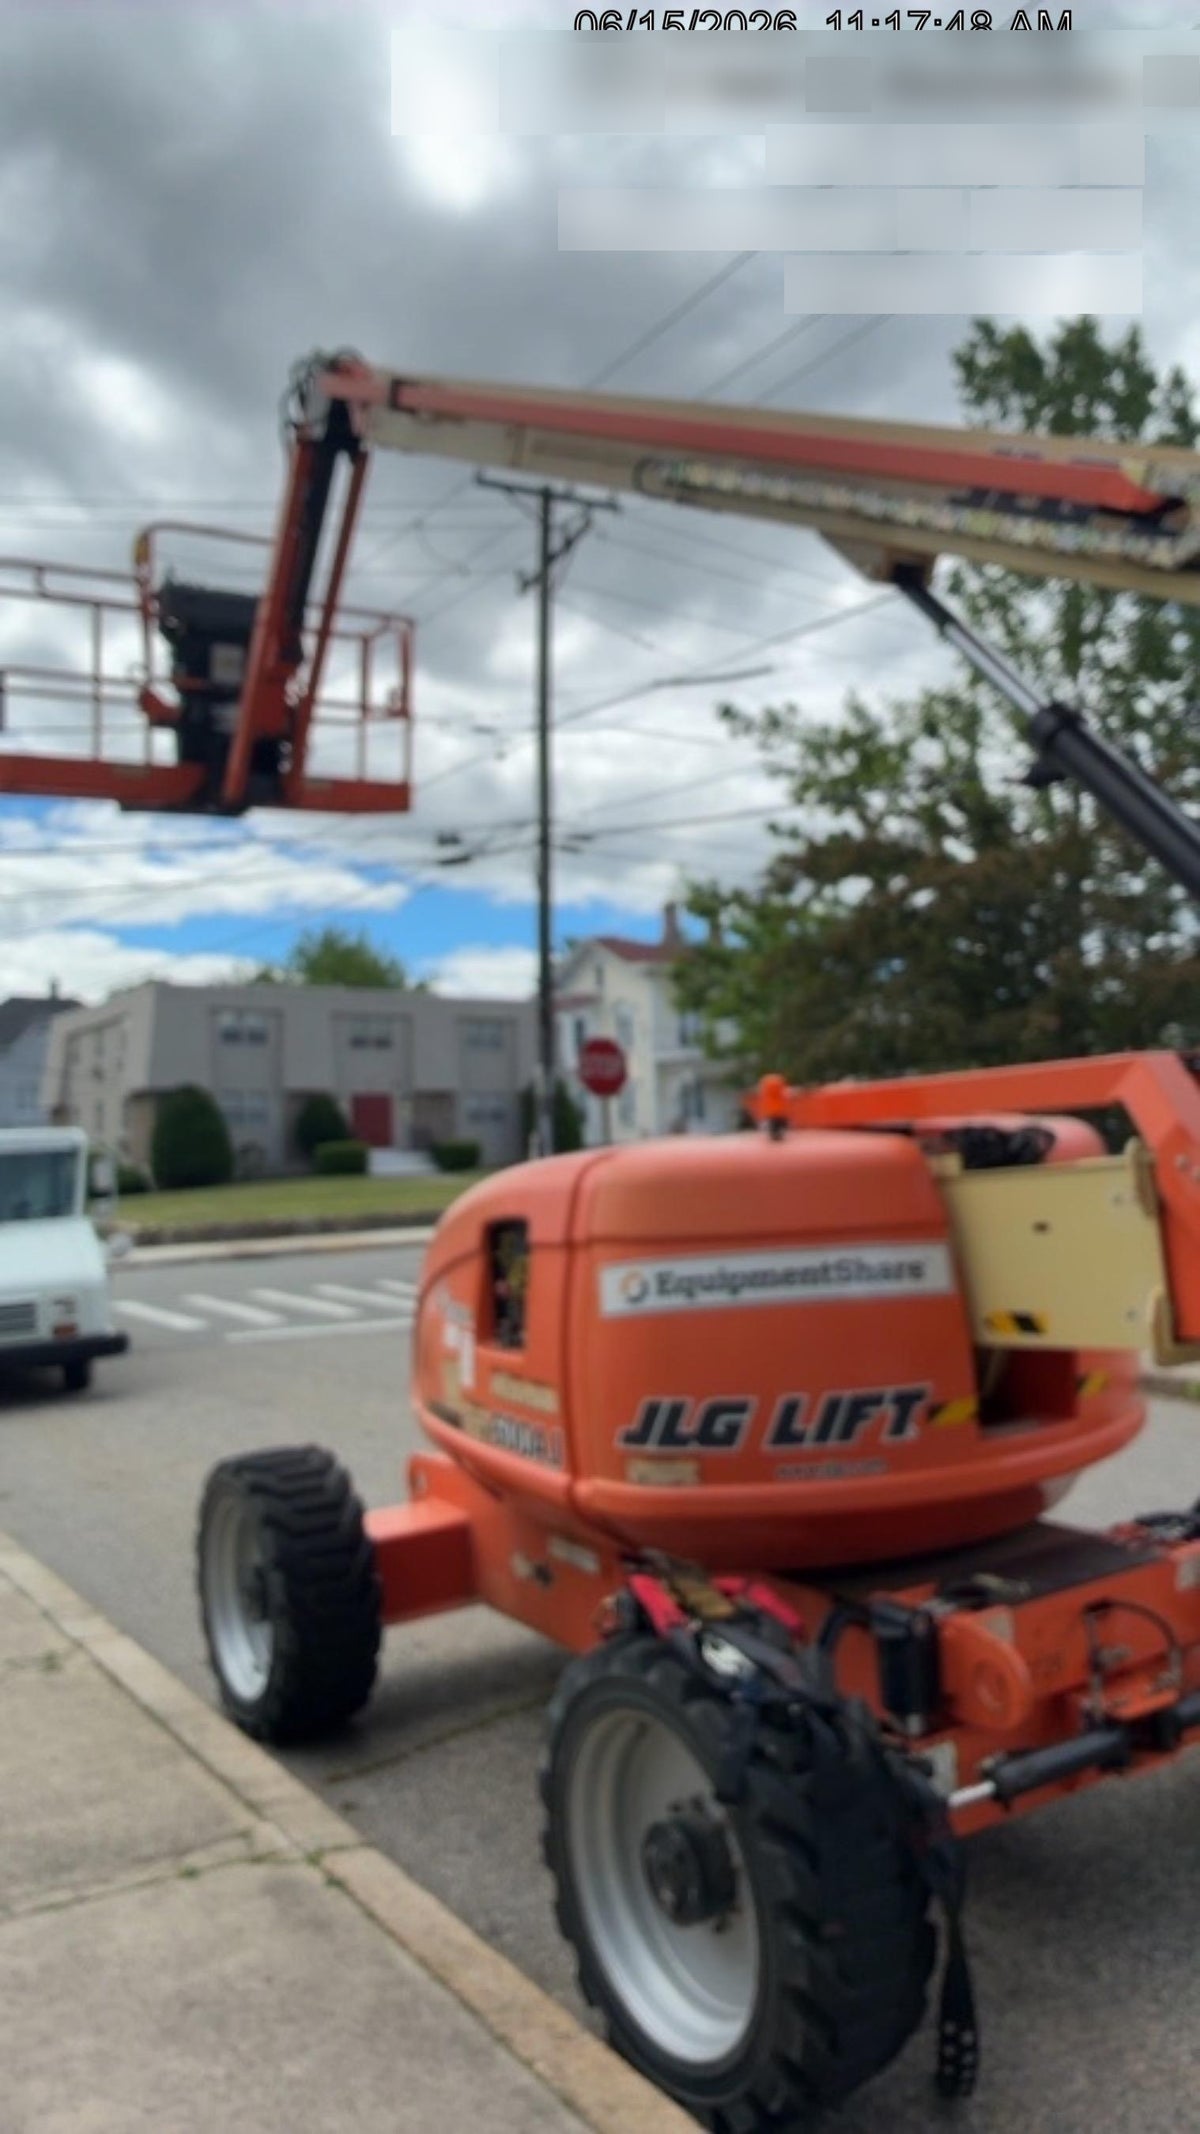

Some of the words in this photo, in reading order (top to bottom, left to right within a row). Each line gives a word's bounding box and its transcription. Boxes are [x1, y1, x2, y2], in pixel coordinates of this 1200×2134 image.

[655, 1259, 927, 1302] EquipmentShare
[618, 1397, 754, 1449] JLG
[766, 1385, 930, 1448] LIFT
